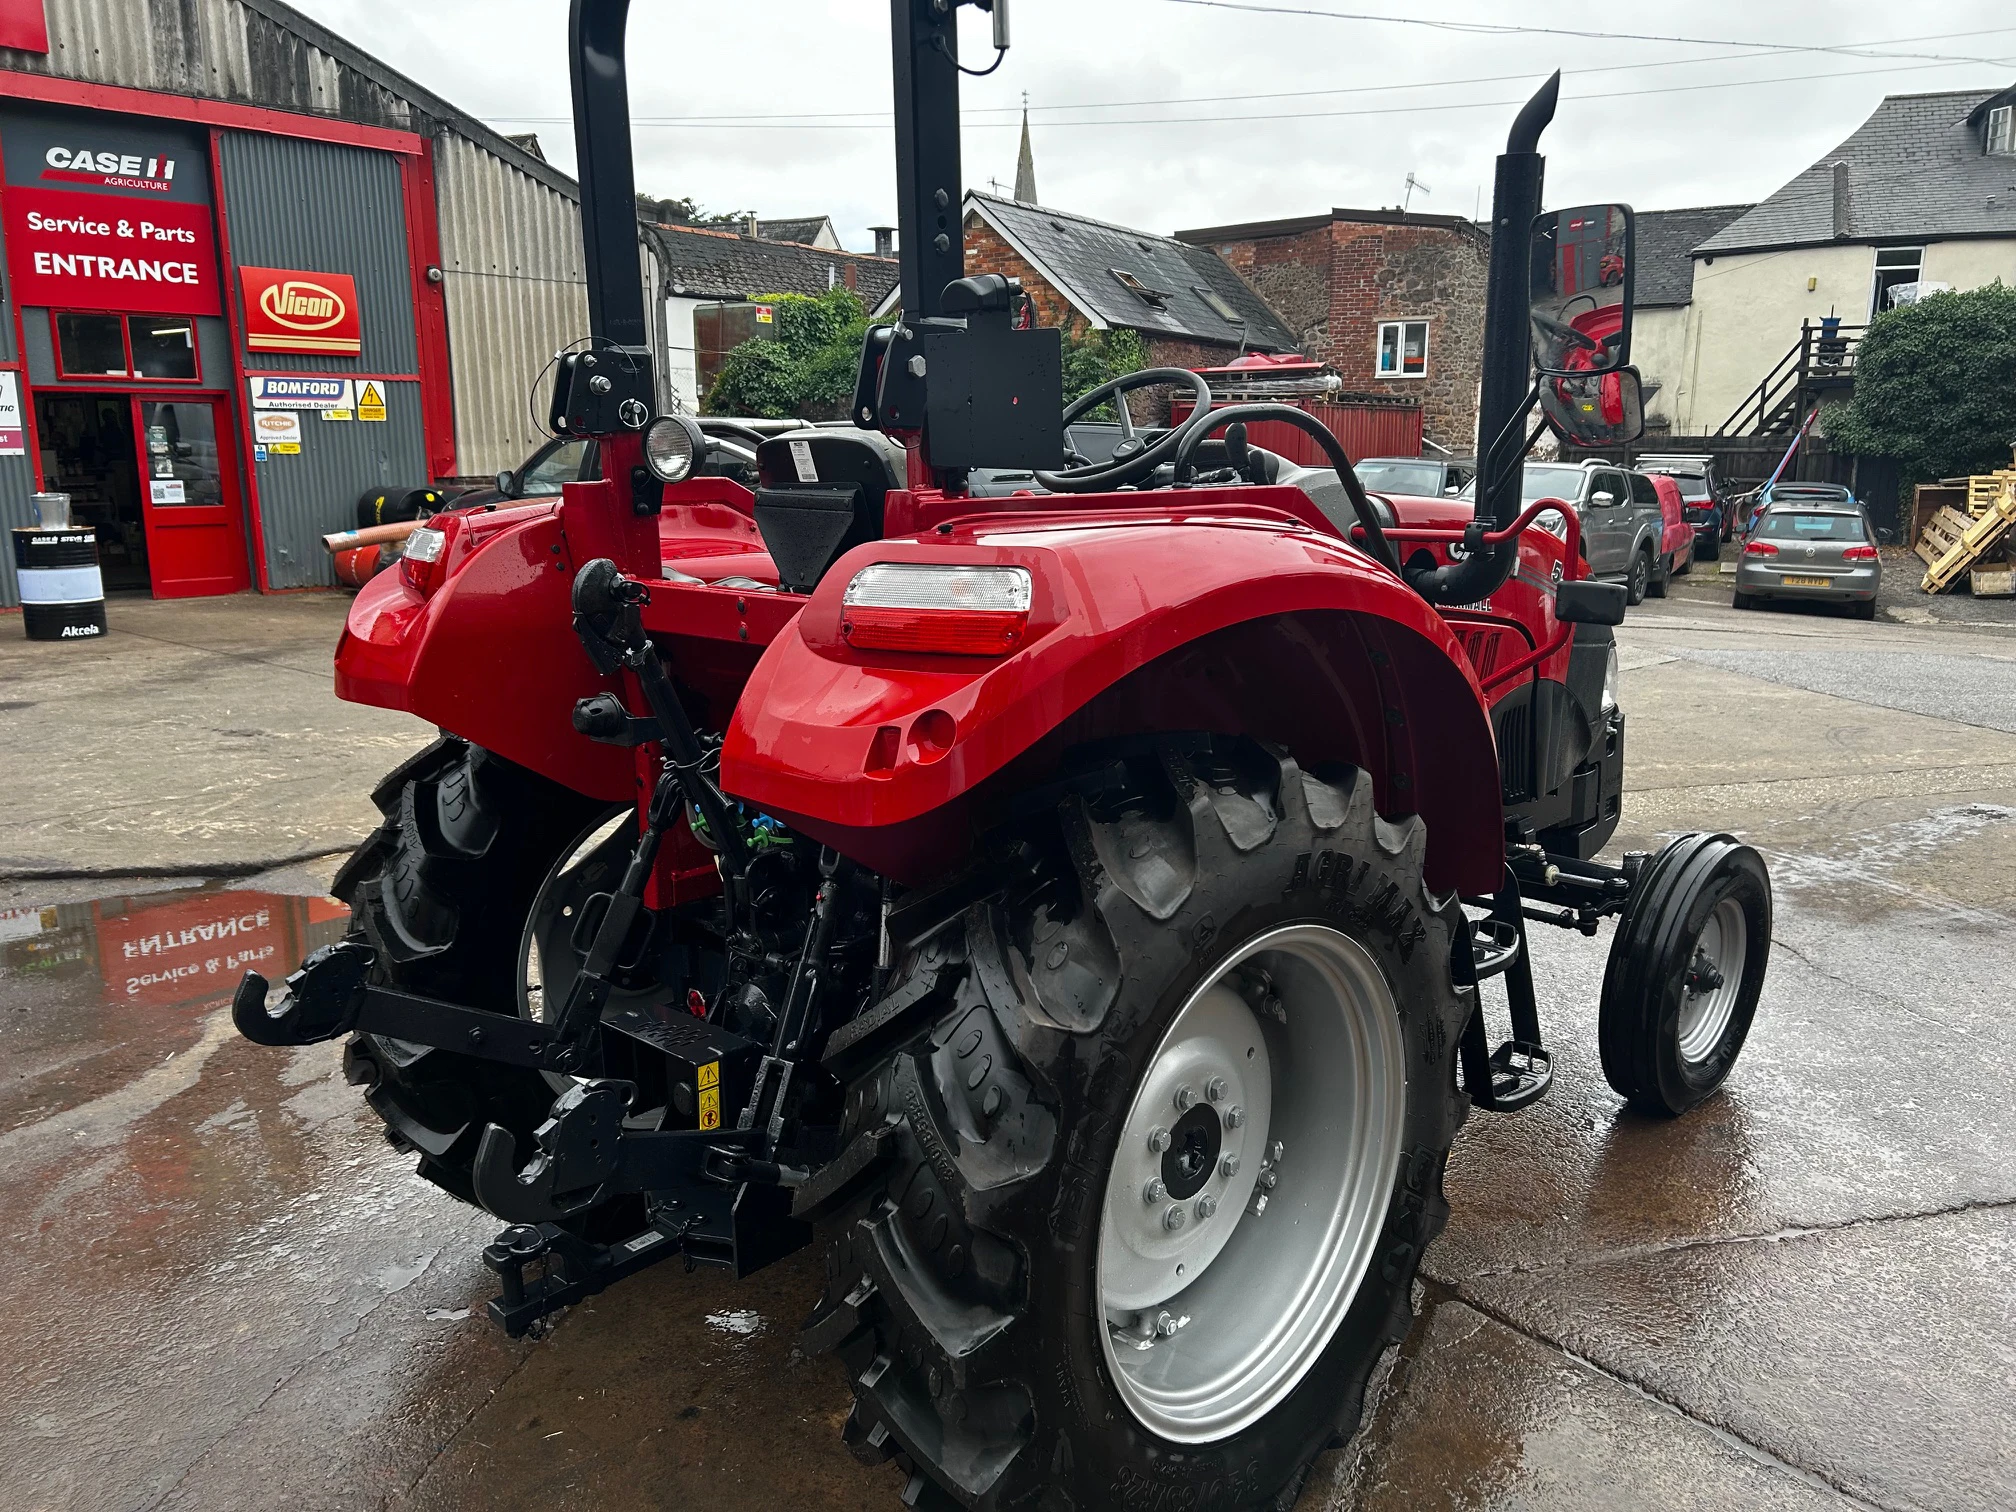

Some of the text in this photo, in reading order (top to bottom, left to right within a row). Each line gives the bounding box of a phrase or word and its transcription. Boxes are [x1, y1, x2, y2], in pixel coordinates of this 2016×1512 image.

[46, 147, 142, 176] CASE
[104, 176, 168, 191] AGRICULTURE
[27, 211, 195, 243] Service & Parts
[34, 252, 199, 284] ENTRANCE
[272, 283, 334, 318] Vicon
[267, 381, 339, 395] BOMFORD
[269, 401, 311, 409] Authorised
[261, 419, 292, 427] RITCHIE
[61, 624, 99, 637] Akcela
